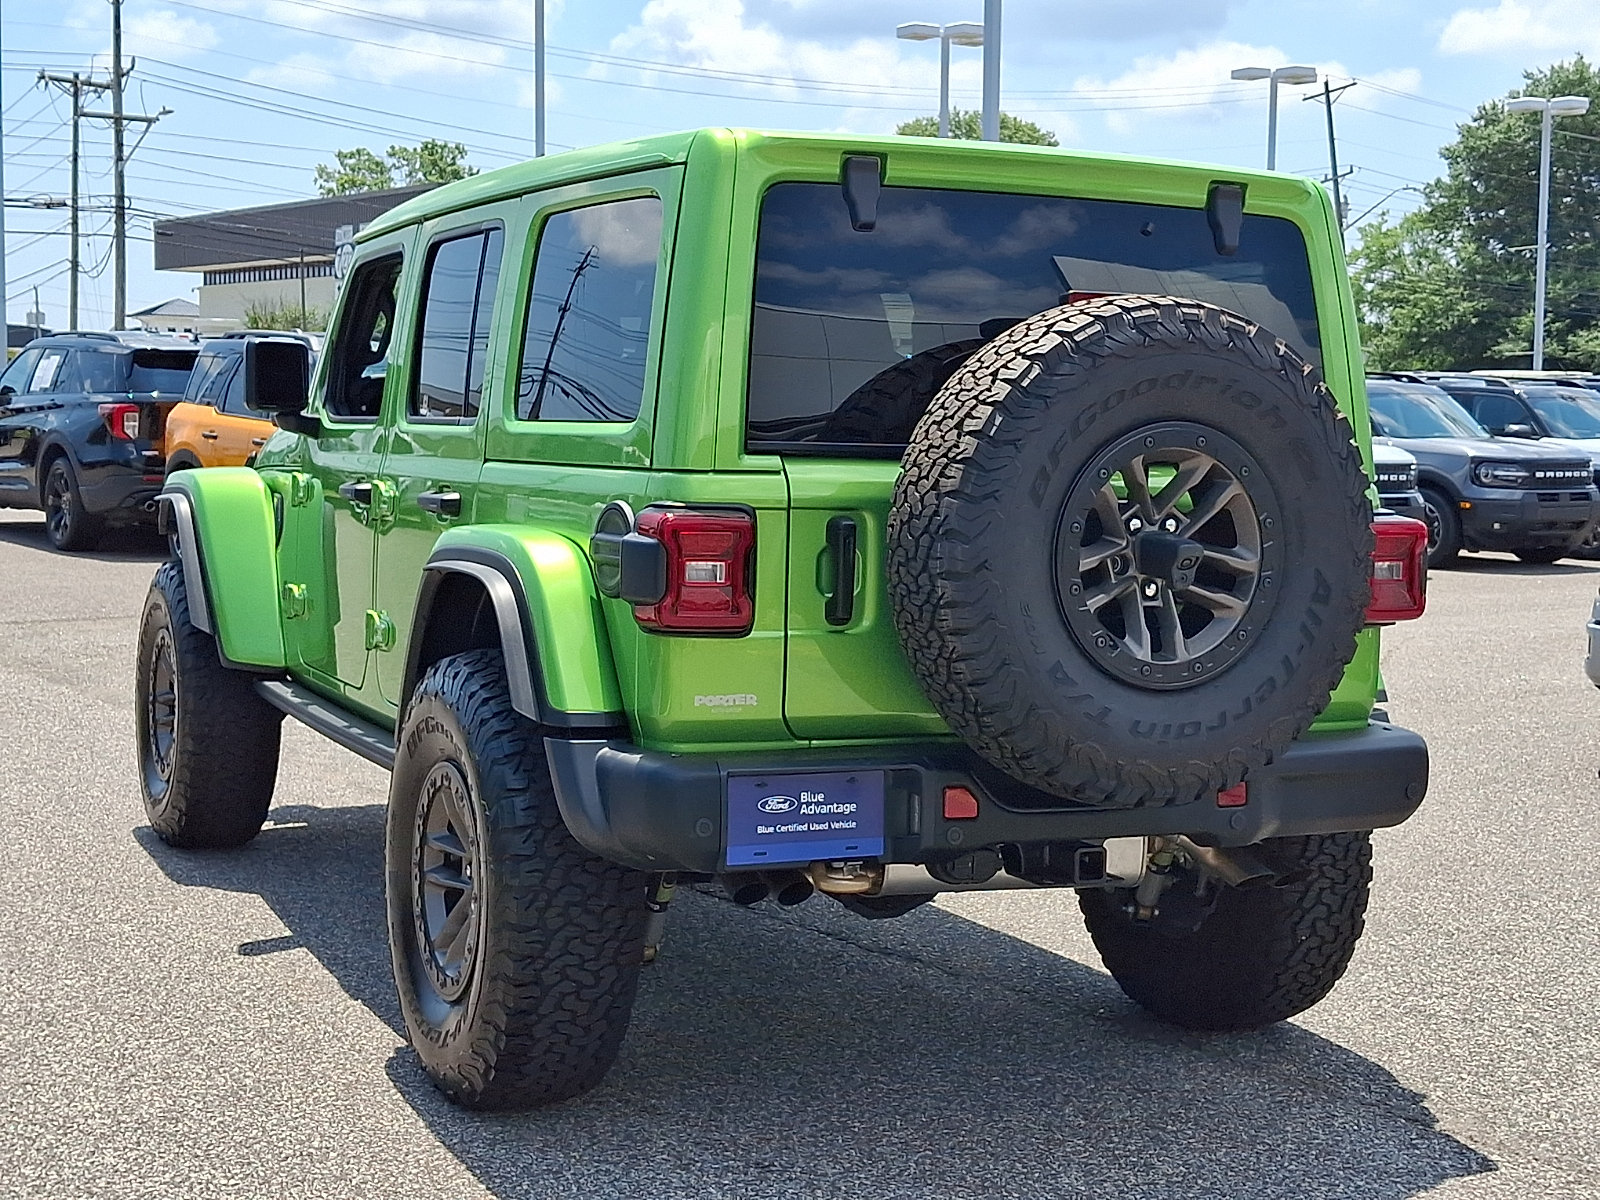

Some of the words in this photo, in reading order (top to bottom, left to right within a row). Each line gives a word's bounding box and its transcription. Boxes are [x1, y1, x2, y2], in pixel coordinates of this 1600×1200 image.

[1028, 370, 1288, 508] BFGoodrich
[1535, 470, 1588, 478] BRONCO
[694, 694, 758, 706] PORTER
[801, 791, 825, 802] Blue
[765, 799, 791, 810] Ford
[800, 803, 857, 815] Advantage
[757, 825, 775, 834] Blue
[776, 823, 808, 833] Certified
[809, 821, 829, 831] Used
[830, 820, 857, 830] Vehicle
